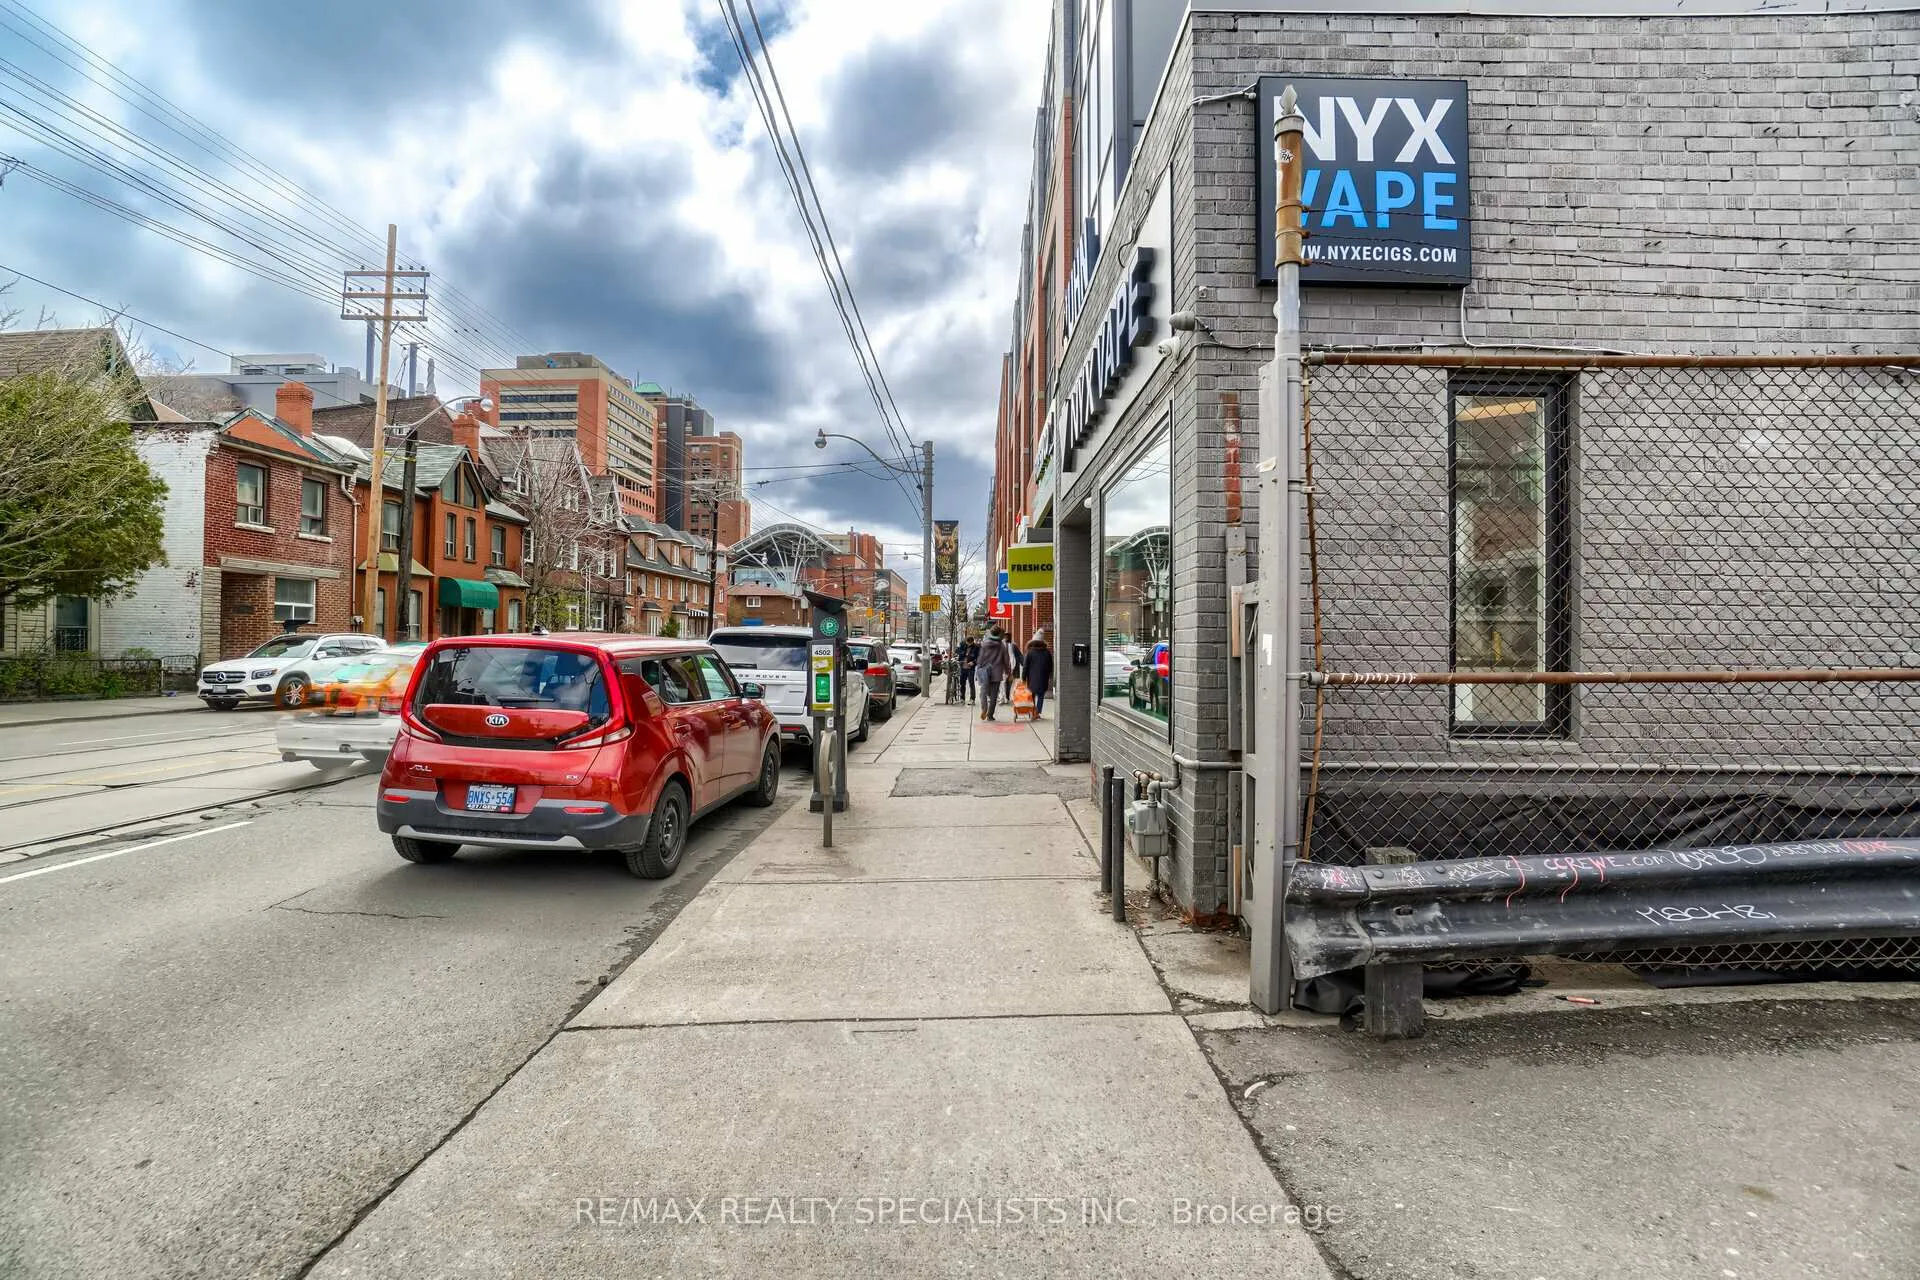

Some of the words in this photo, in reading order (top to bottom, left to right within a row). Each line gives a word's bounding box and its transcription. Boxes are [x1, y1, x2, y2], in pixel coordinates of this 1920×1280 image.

[1273, 96, 1456, 164] NYX
[1096, 247, 1142, 399] VAPE
[487, 714, 508, 726] KIA
